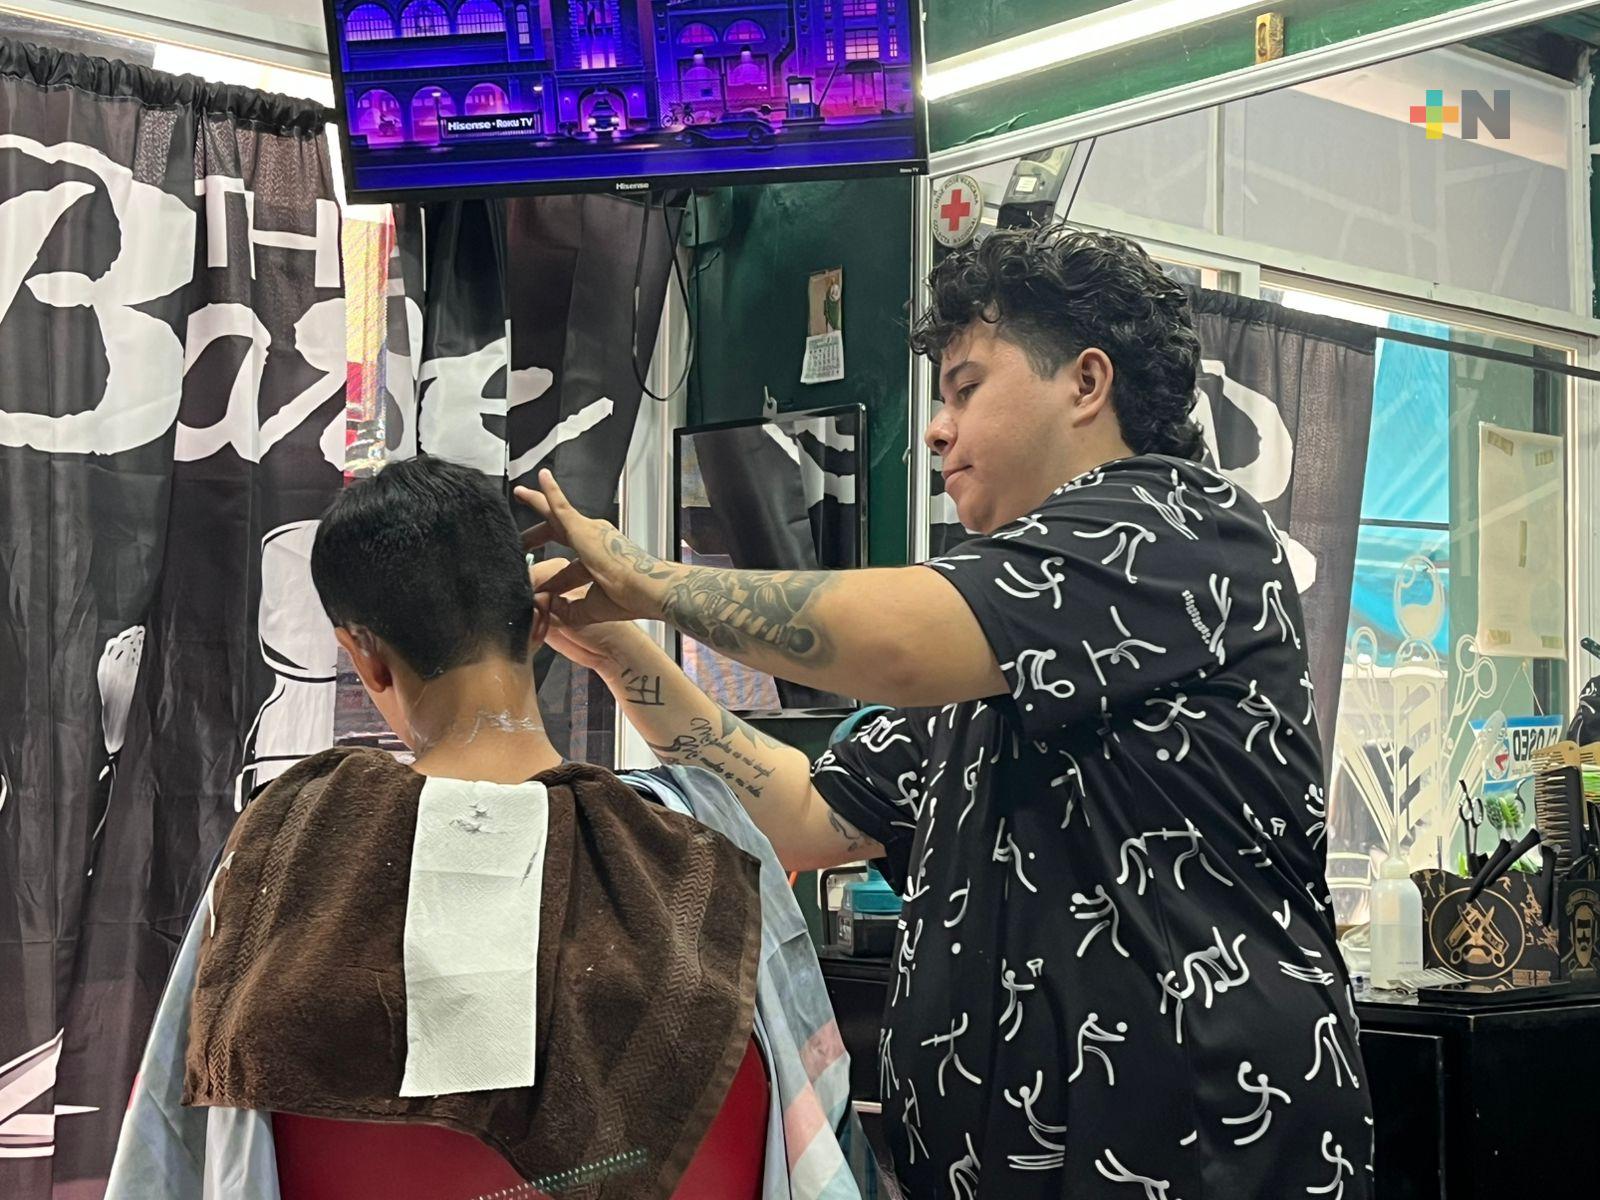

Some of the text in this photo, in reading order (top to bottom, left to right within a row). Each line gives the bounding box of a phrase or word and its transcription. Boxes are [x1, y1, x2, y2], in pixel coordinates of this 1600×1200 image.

[448, 118, 533, 131] Hisense Roku TV
